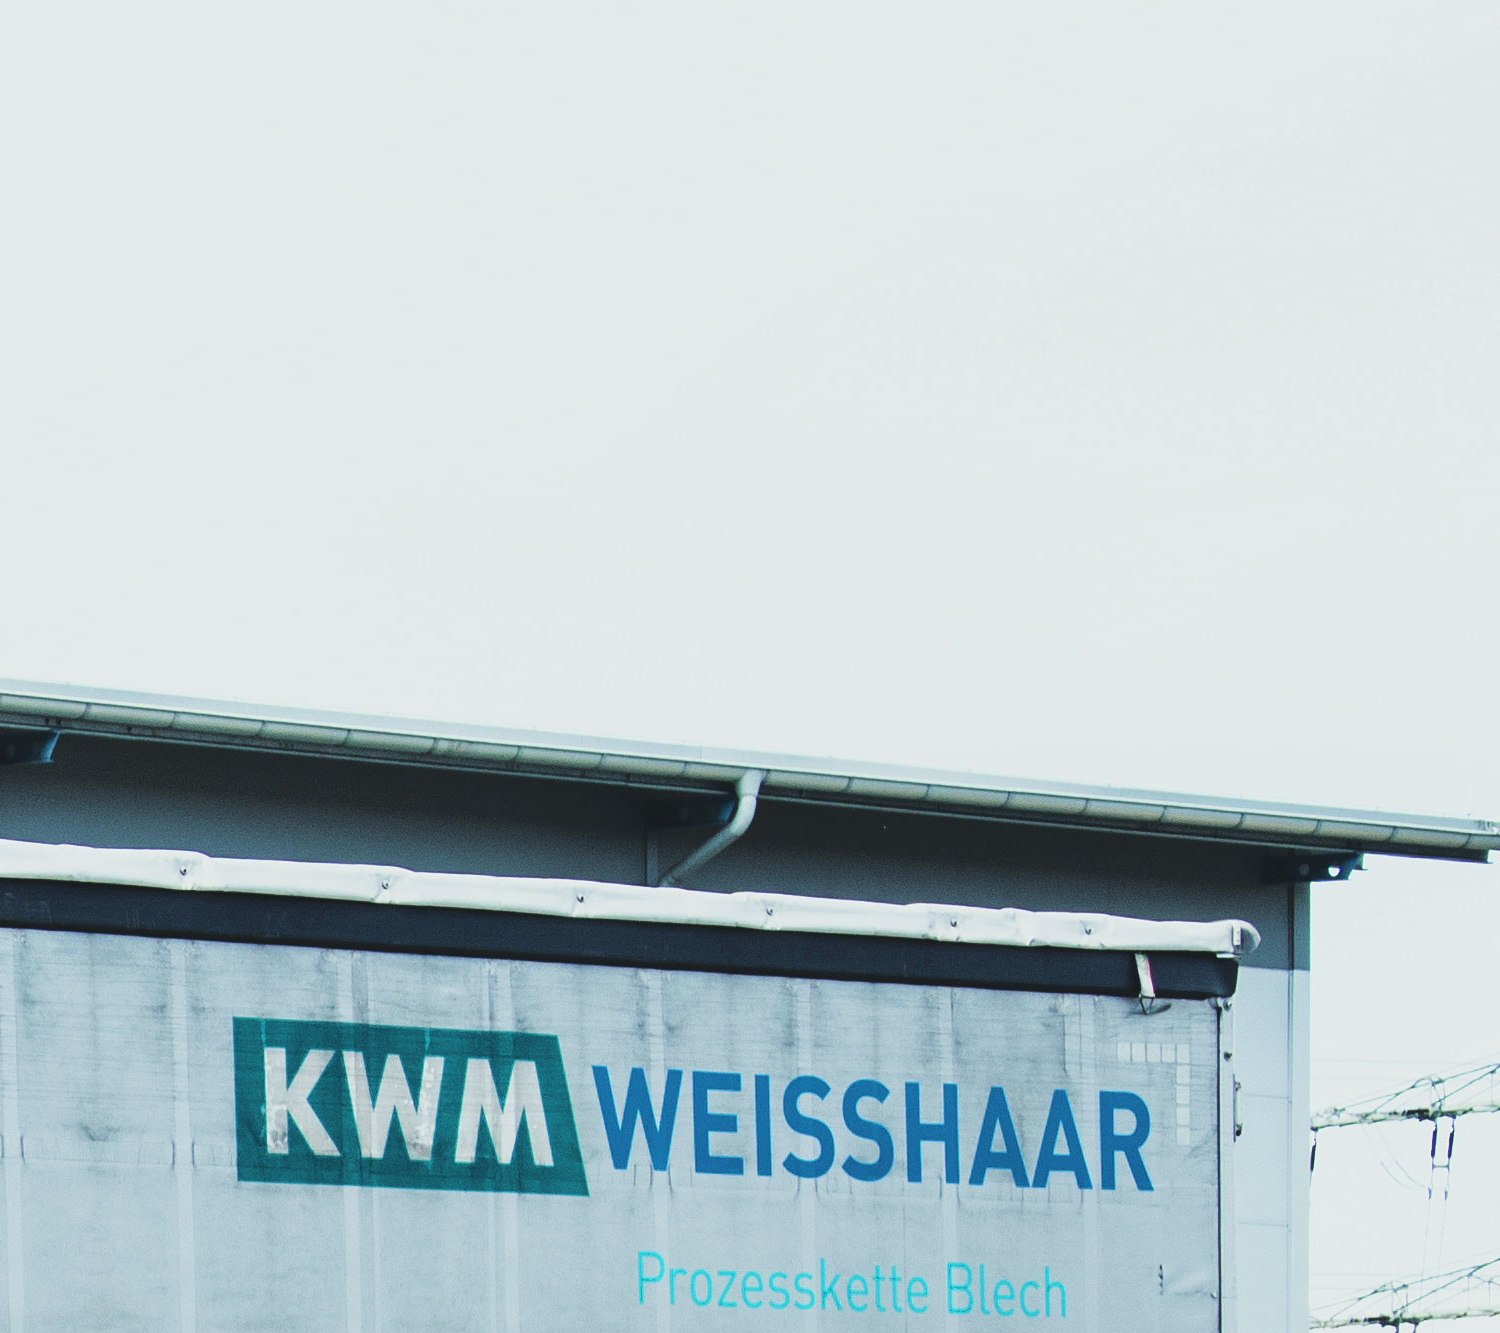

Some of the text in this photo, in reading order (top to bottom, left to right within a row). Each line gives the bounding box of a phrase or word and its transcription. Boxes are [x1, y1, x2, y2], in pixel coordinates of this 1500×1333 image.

[264, 1047, 1154, 1191] KWM WEISSHAAR
[637, 1251, 1066, 1317] Prozesskette Blech
